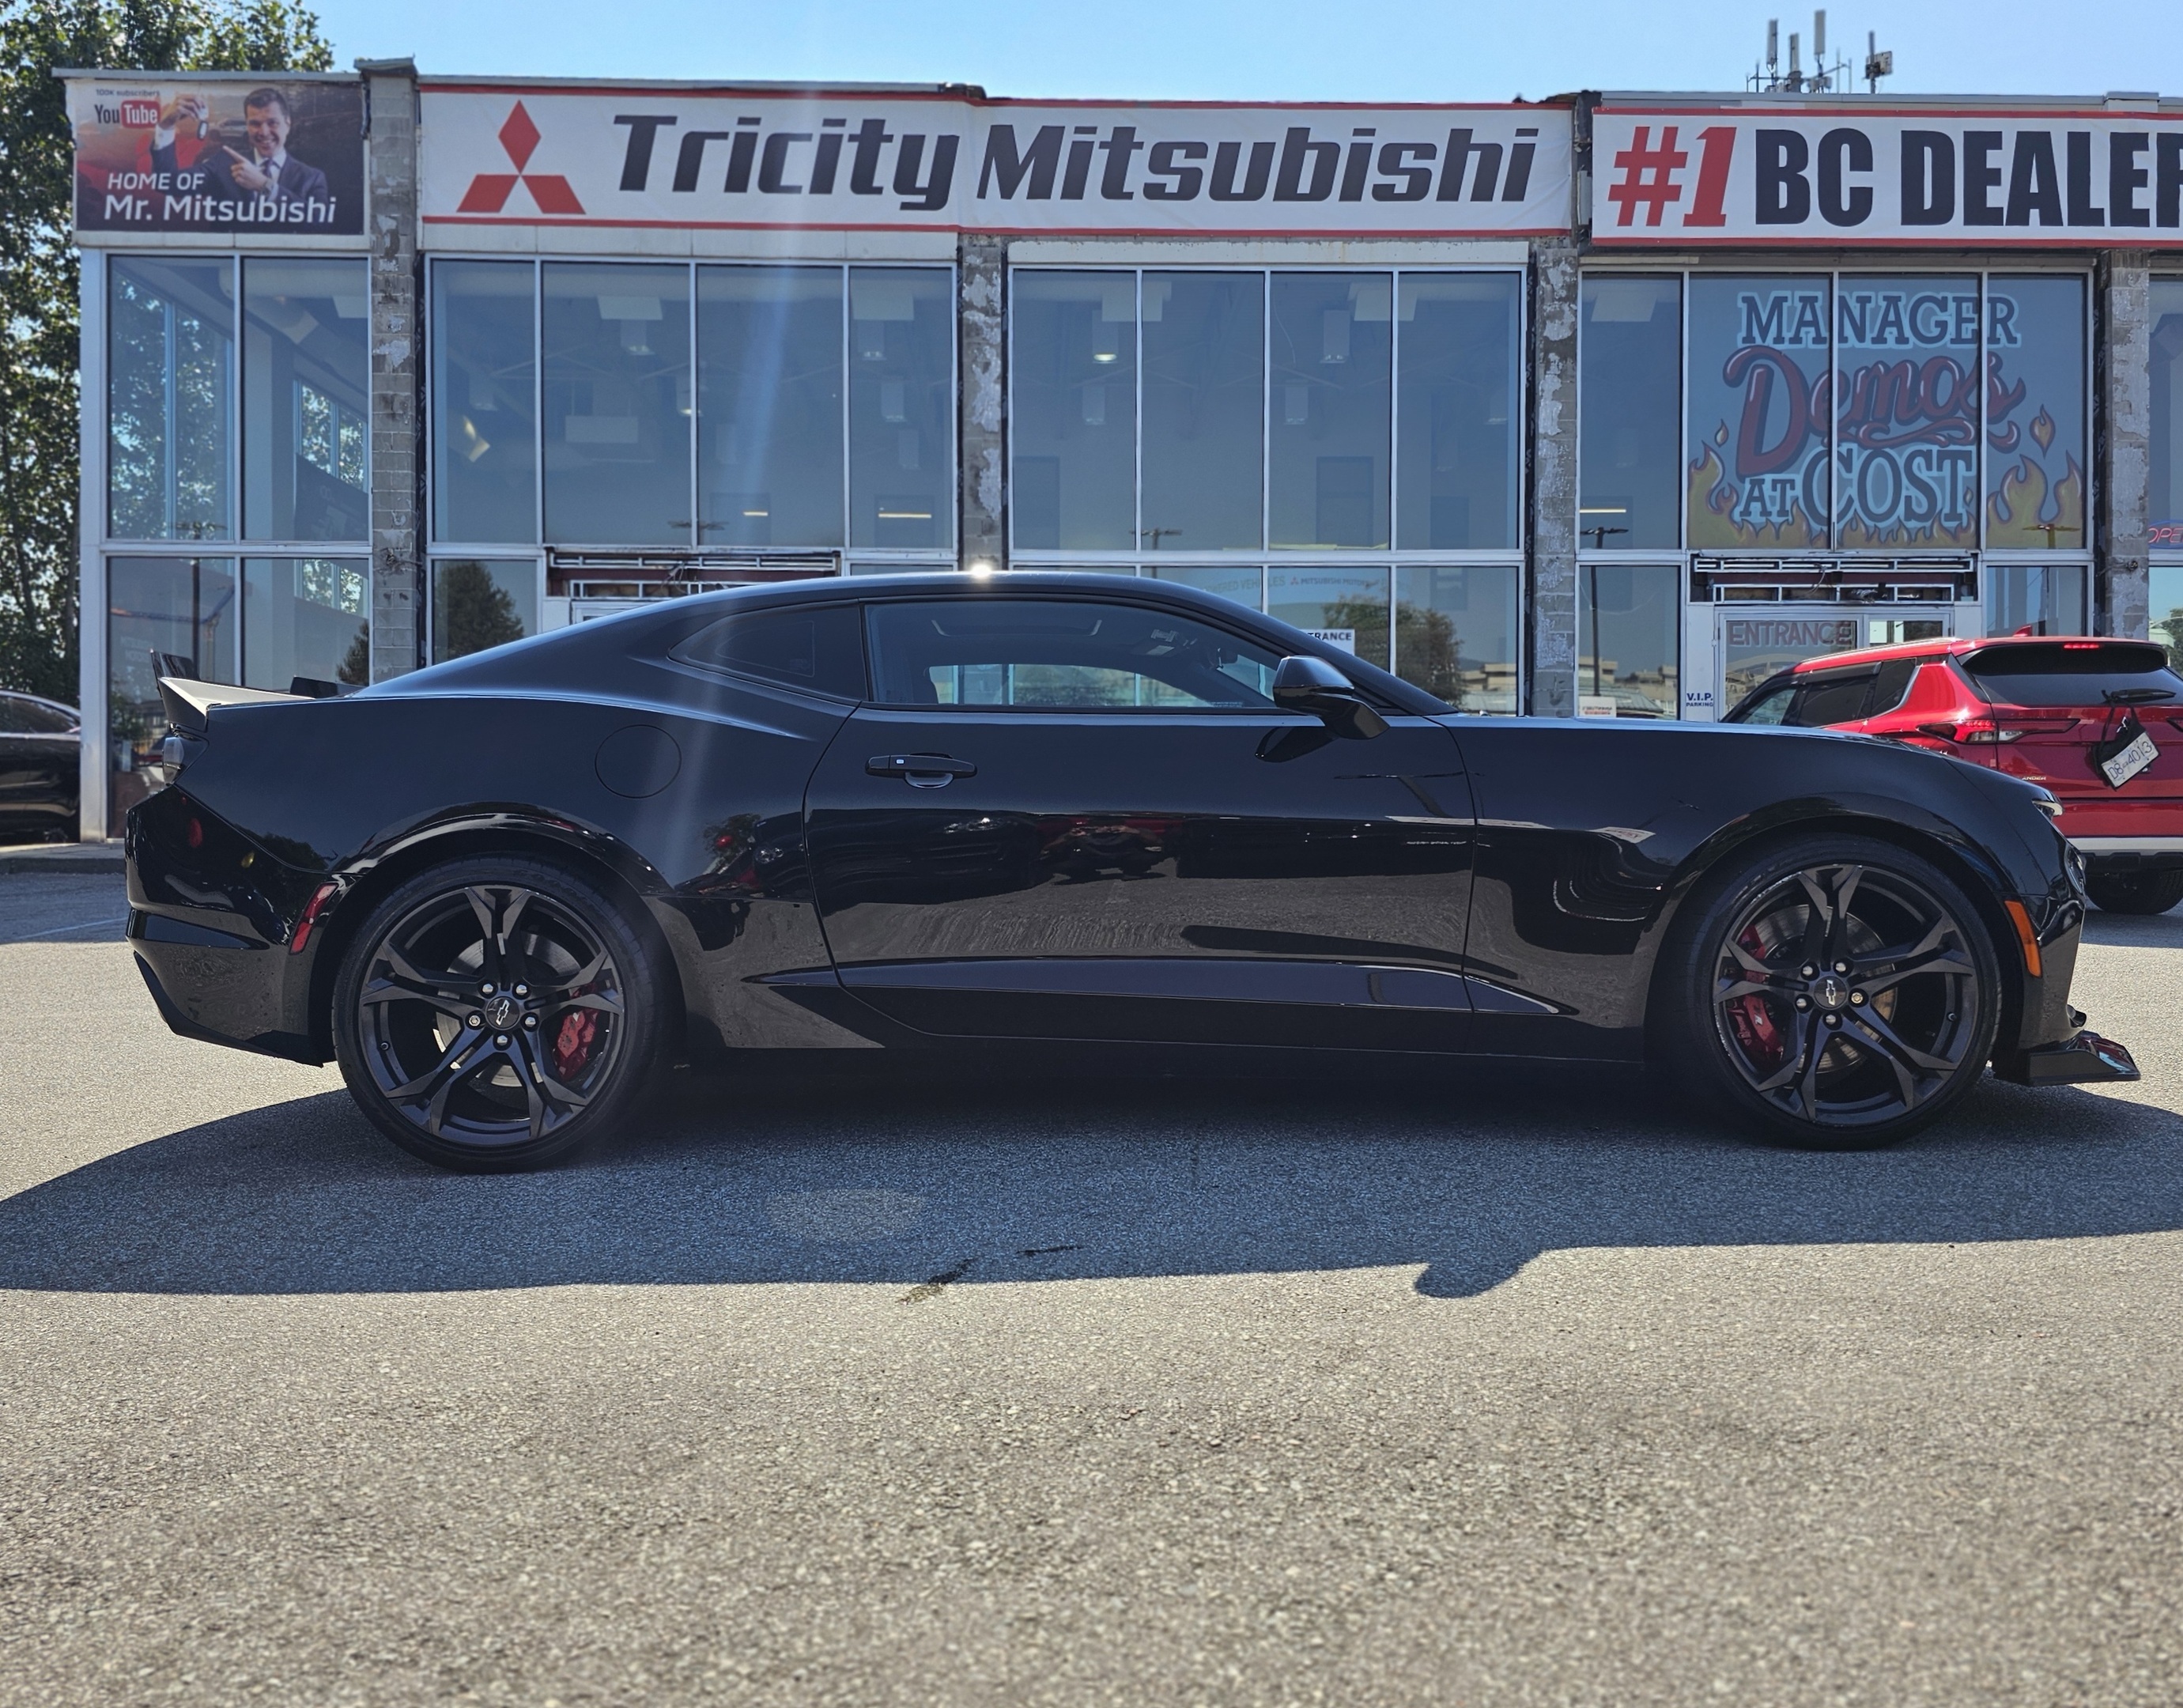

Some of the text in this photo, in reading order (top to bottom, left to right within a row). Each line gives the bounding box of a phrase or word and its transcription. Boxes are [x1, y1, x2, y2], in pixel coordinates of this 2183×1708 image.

[108, 172, 206, 191] HOME OF
[613, 115, 1539, 211] Tricity Mitsubishi
[1607, 126, 1737, 227] #1
[1755, 127, 1874, 227] BC
[104, 195, 337, 223] Mr. Mitsubishi
[1740, 293, 2019, 347] MANAGER
[1722, 345, 2026, 480] Demos
[1739, 448, 1973, 527] AT COST
[1728, 621, 1853, 646] ENTRANCE
